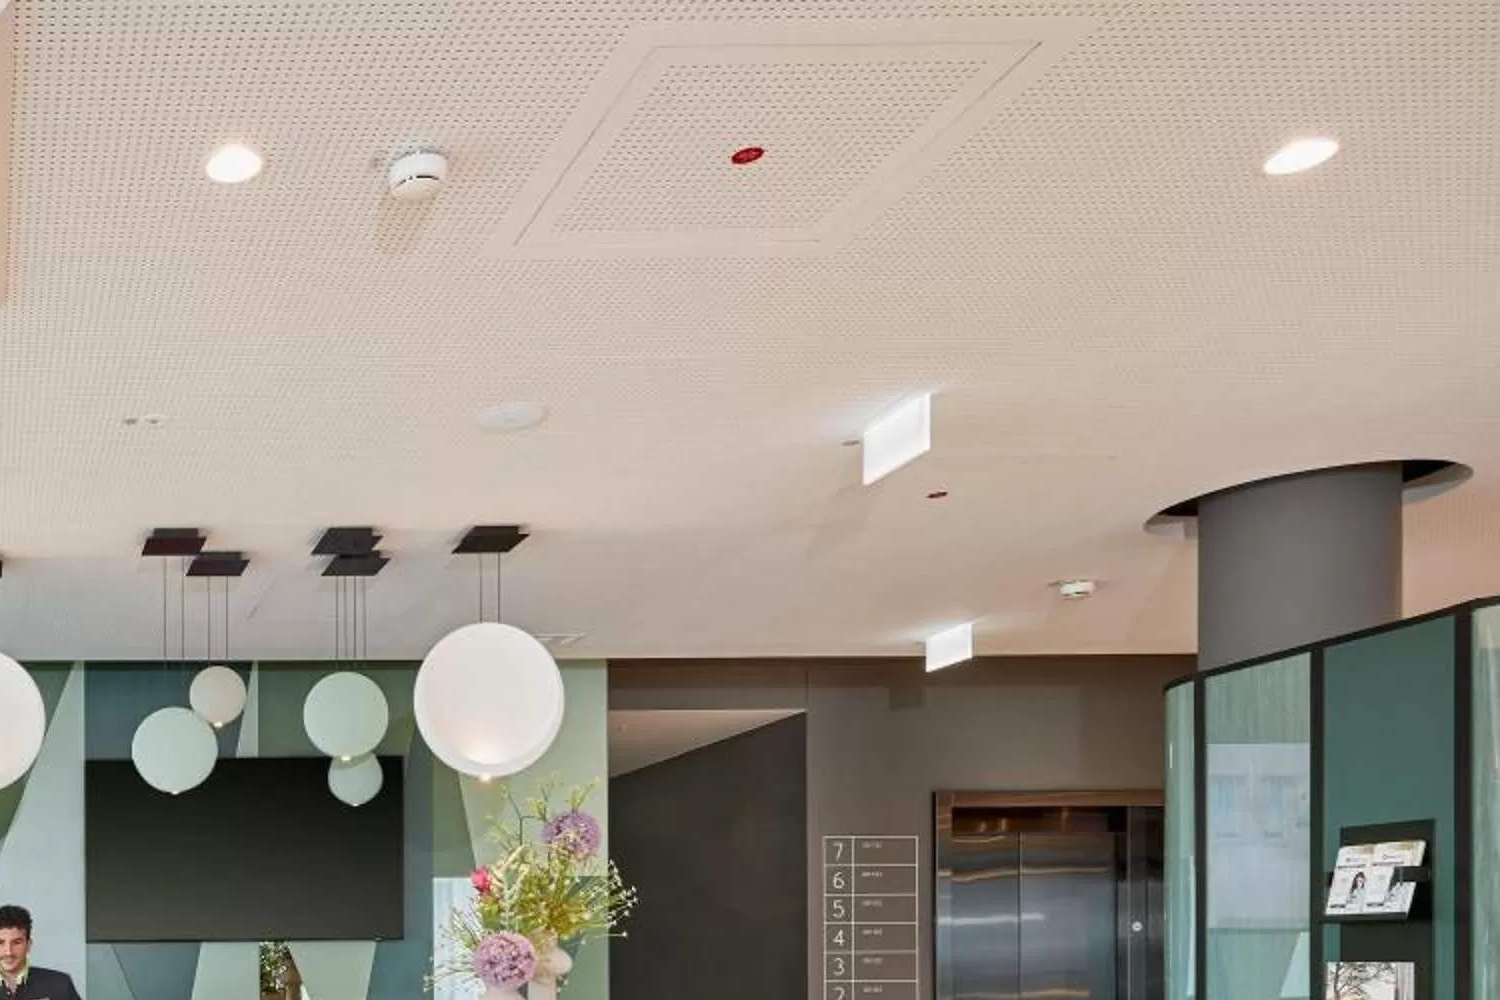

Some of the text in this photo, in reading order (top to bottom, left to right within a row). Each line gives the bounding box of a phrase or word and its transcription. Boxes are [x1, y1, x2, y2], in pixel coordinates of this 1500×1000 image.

[833, 842, 843, 861] 7
[833, 871, 845, 889] 6
[833, 899, 845, 918] 5
[833, 929, 845, 946] 4
[833, 957, 845, 976] 3
